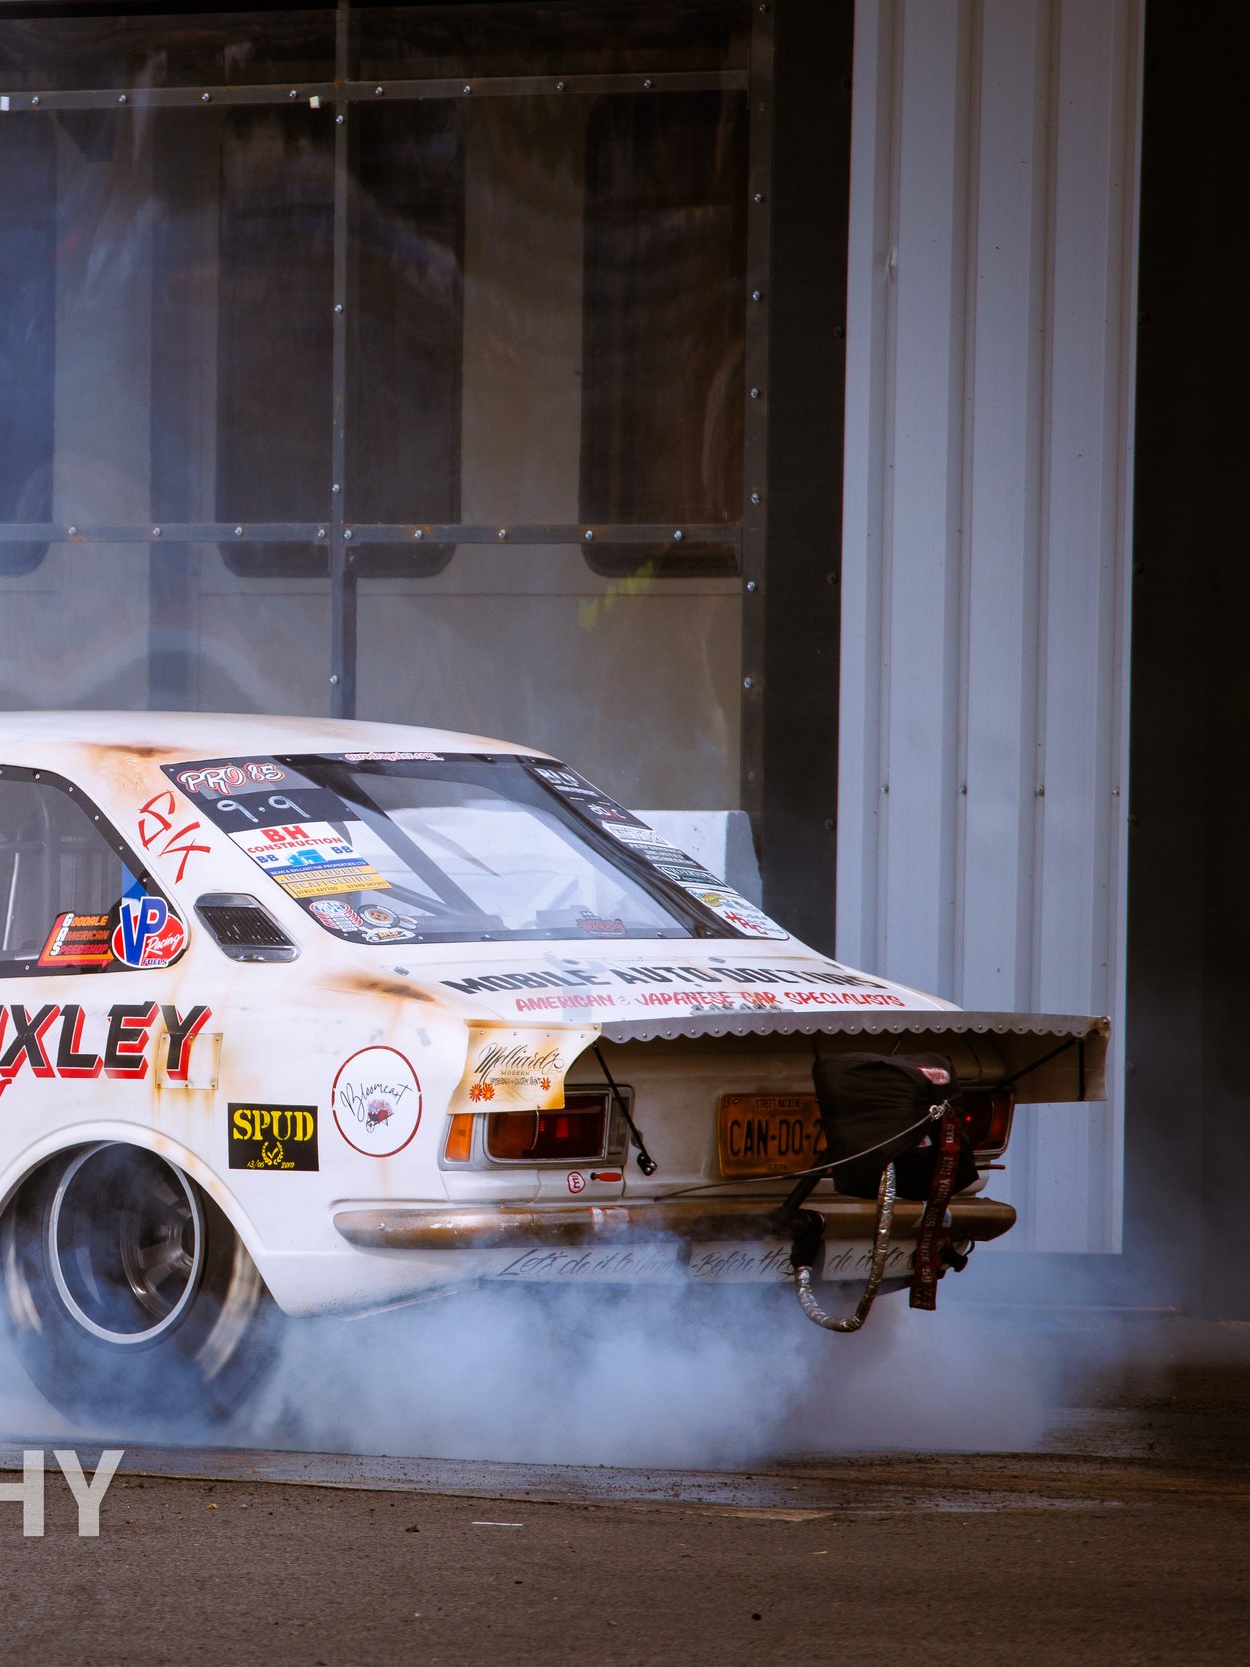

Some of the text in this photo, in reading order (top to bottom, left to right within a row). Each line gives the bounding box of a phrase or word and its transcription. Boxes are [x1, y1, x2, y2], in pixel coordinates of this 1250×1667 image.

[177, 763, 286, 795] PRO 85
[260, 825, 310, 843] BH
[247, 837, 344, 854] CONSTRUCTION
[62, 913, 109, 927] GOODALE
[56, 927, 110, 942] AMERICAN
[119, 896, 169, 966] VP
[50, 941, 109, 957] SPEEDSHOP
[144, 932, 185, 957] Racing
[142, 958, 168, 966] FUELS
[439, 966, 888, 995] MOBILE AUTO DOCTORS
[515, 994, 616, 1012] AMERICAN
[634, 991, 733, 1006] JAPANESE
[740, 991, 782, 1005] CAR
[784, 991, 906, 1007] SPECIALISTS
[233, 1109, 315, 1142] SPUD
